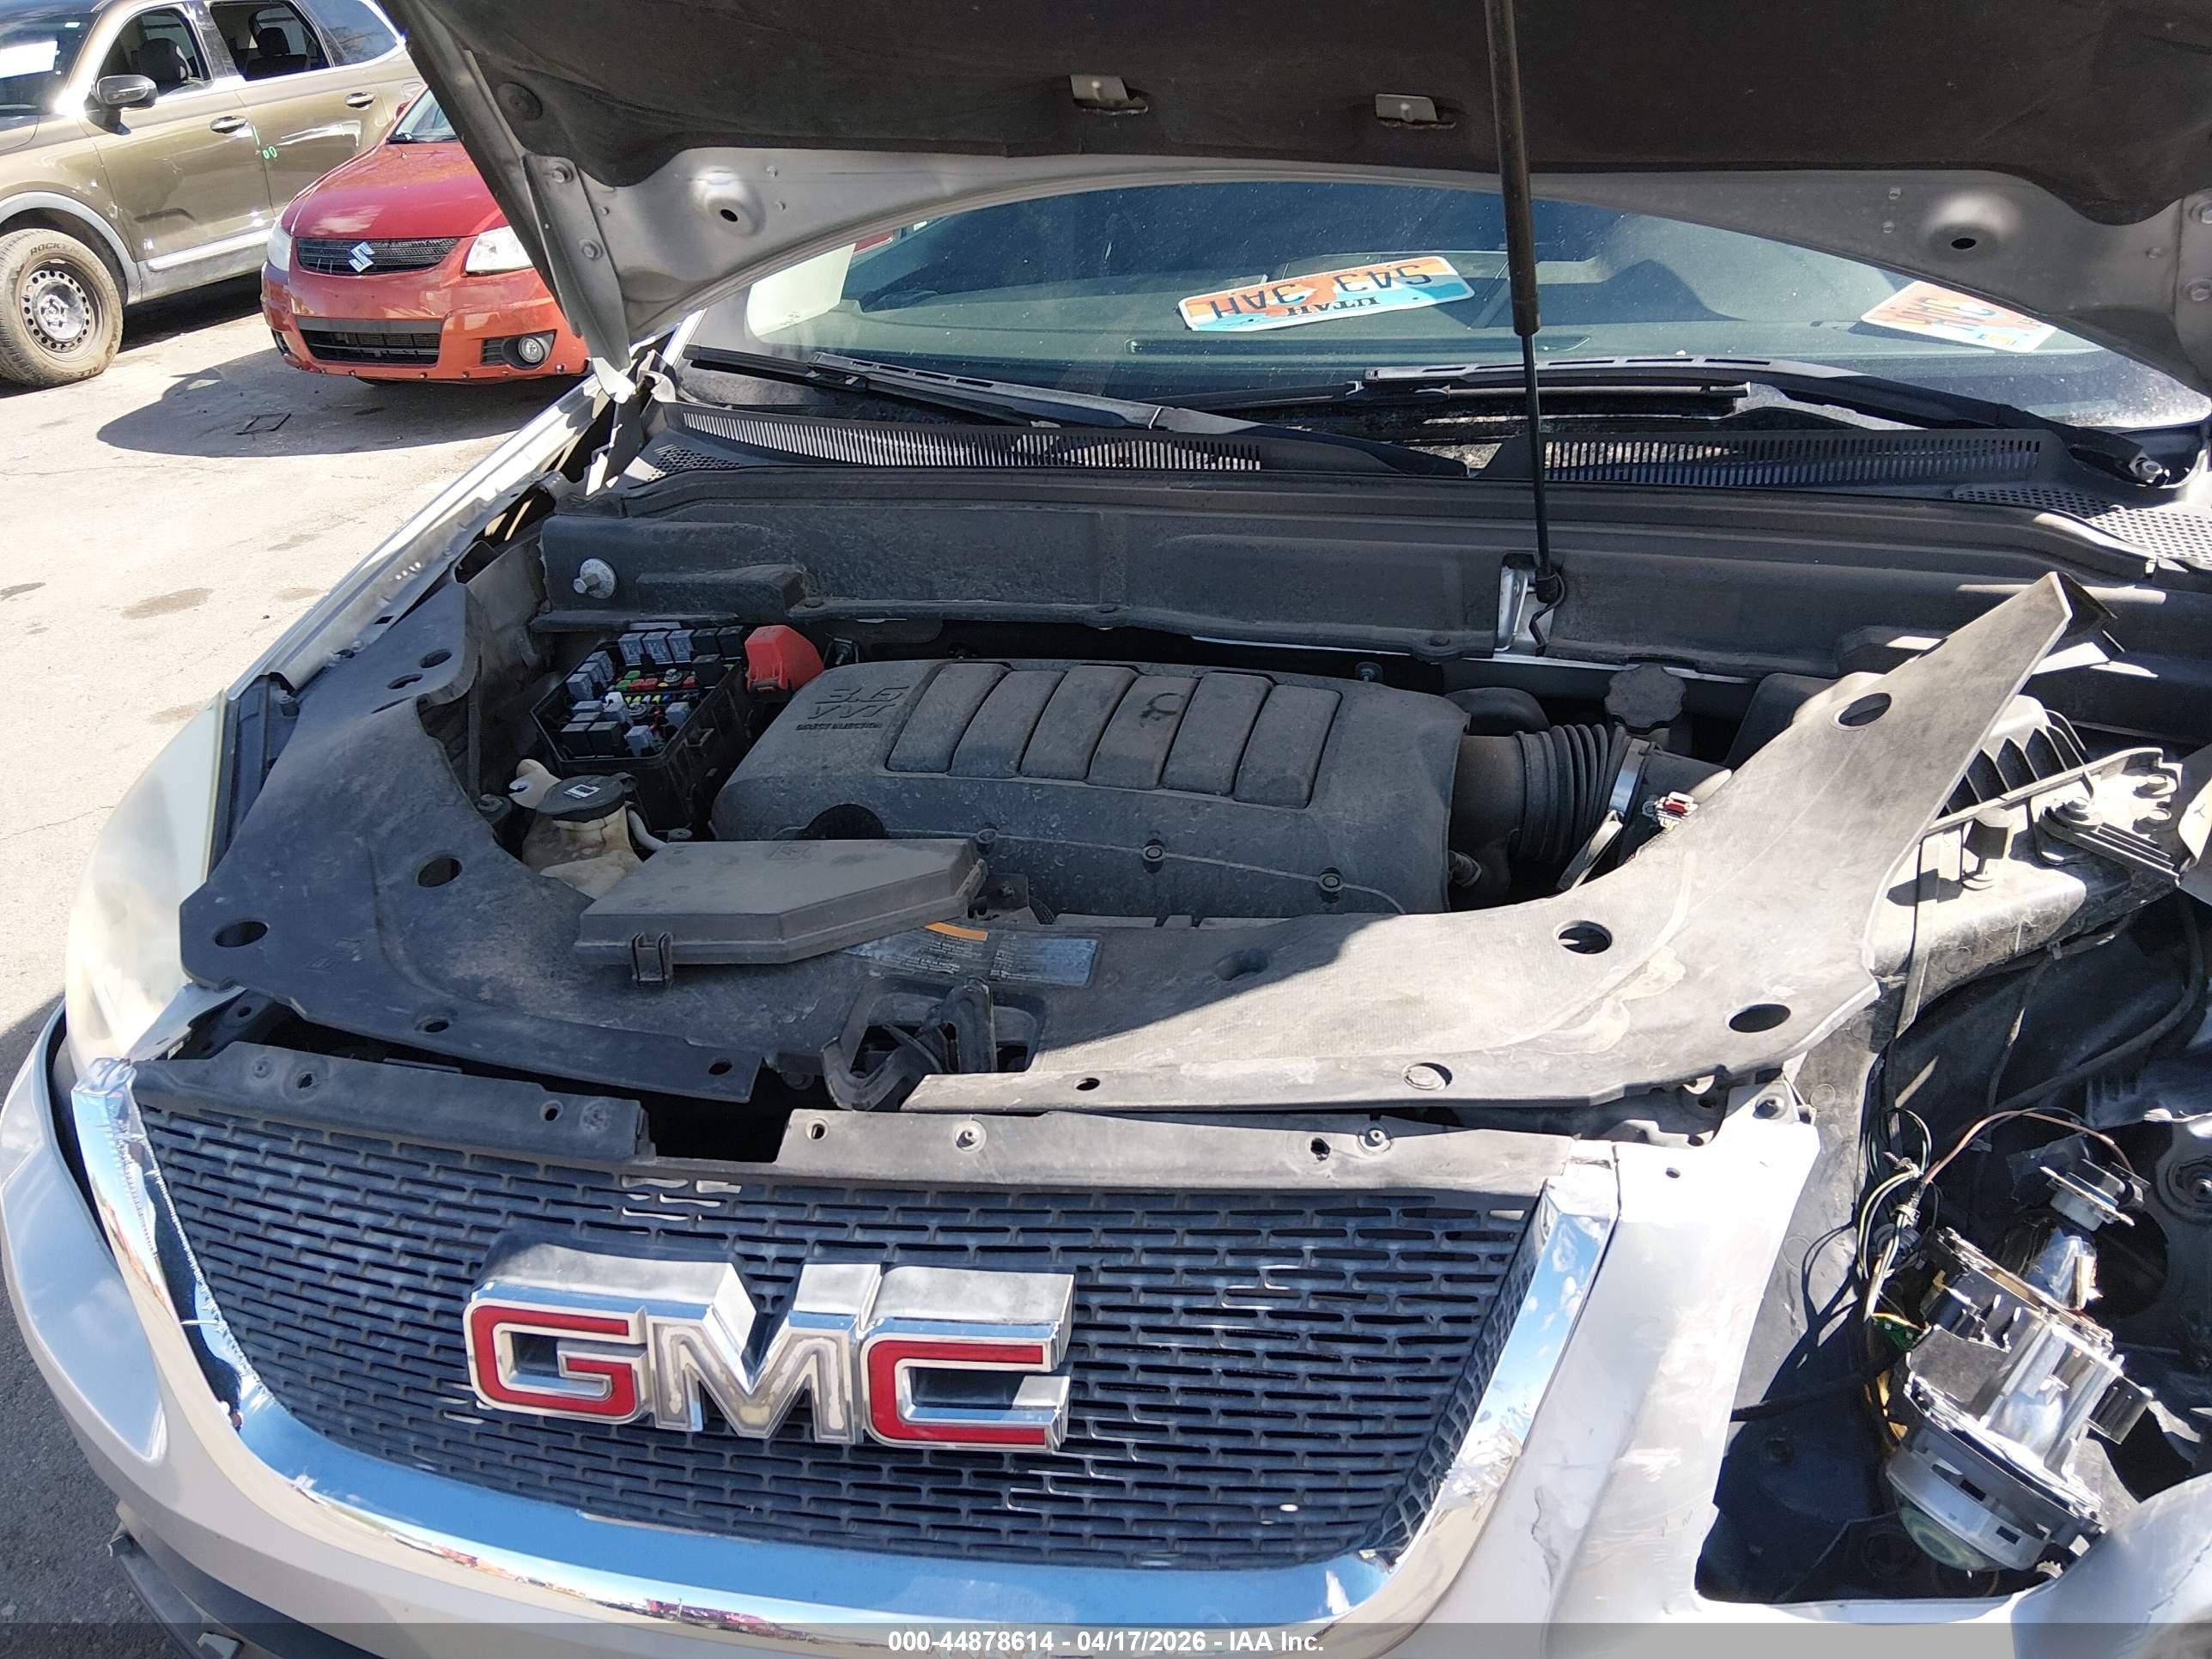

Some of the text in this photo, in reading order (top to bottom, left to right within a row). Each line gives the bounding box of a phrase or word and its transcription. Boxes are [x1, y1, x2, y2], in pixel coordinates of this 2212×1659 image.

[1209, 283, 1305, 319] 3AH
[1285, 296, 1381, 316] UTAH
[465, 1264, 1073, 1451] GMC
